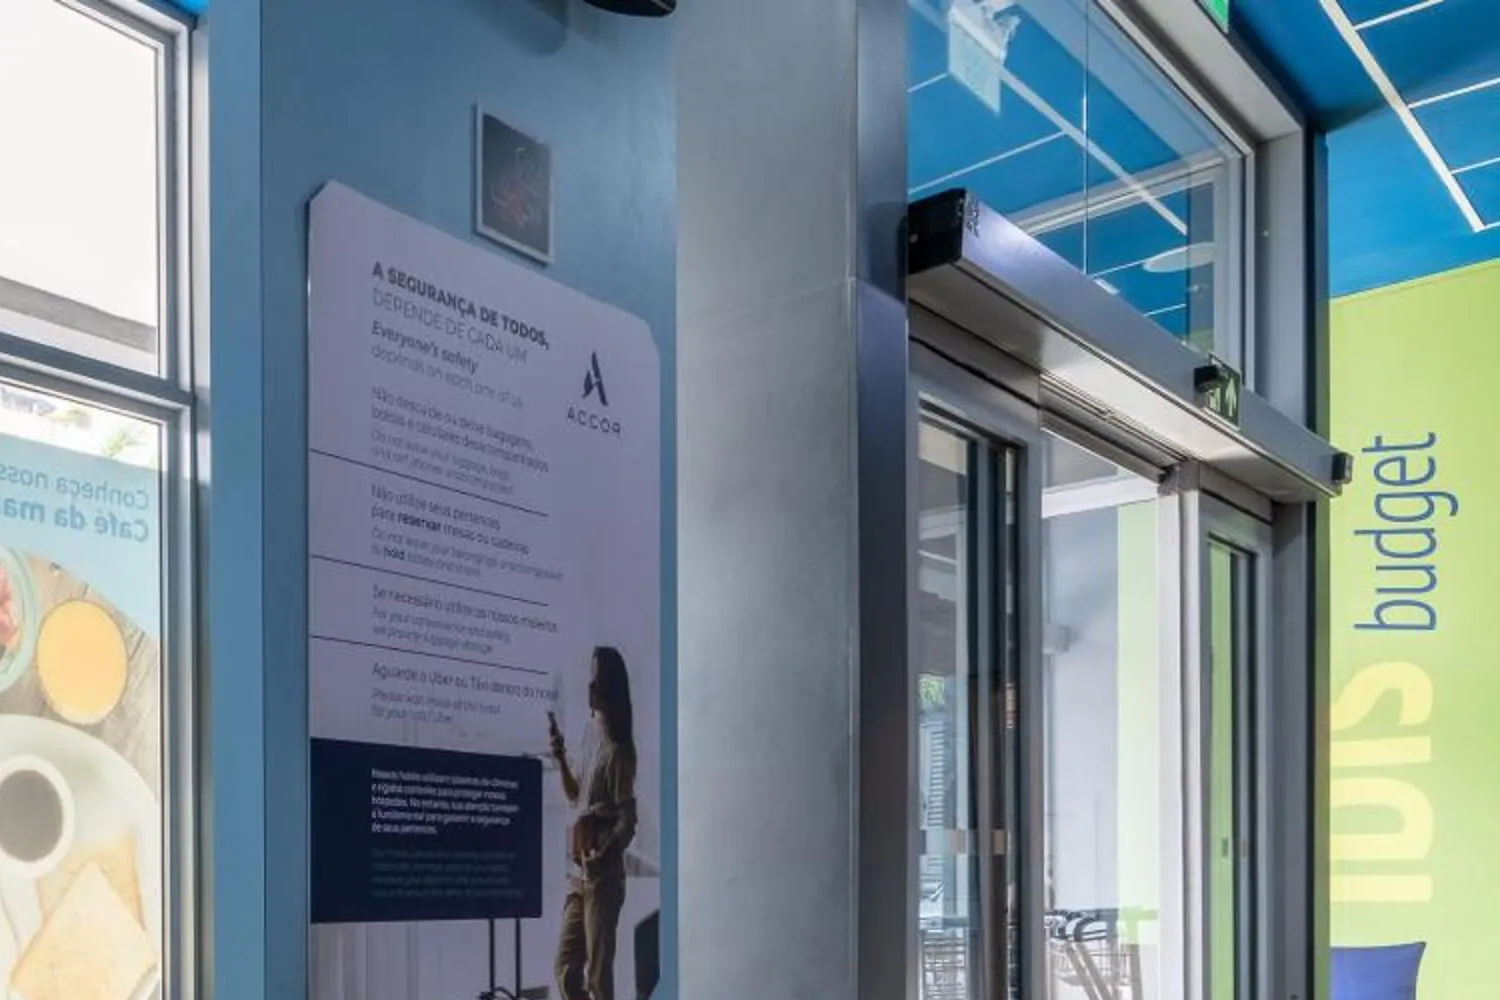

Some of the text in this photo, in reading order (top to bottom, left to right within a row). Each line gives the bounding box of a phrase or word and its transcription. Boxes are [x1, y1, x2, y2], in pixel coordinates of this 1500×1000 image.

[372, 261, 549, 351] A SEGURANÇA DE TODOS,
[373, 289, 527, 365] DEPENDE DE CADA UM
[372, 322, 478, 375] Everyone's safety
[567, 406, 621, 438] ACCOR
[397, 513, 441, 533] reservar
[1353, 431, 1459, 631] budget
